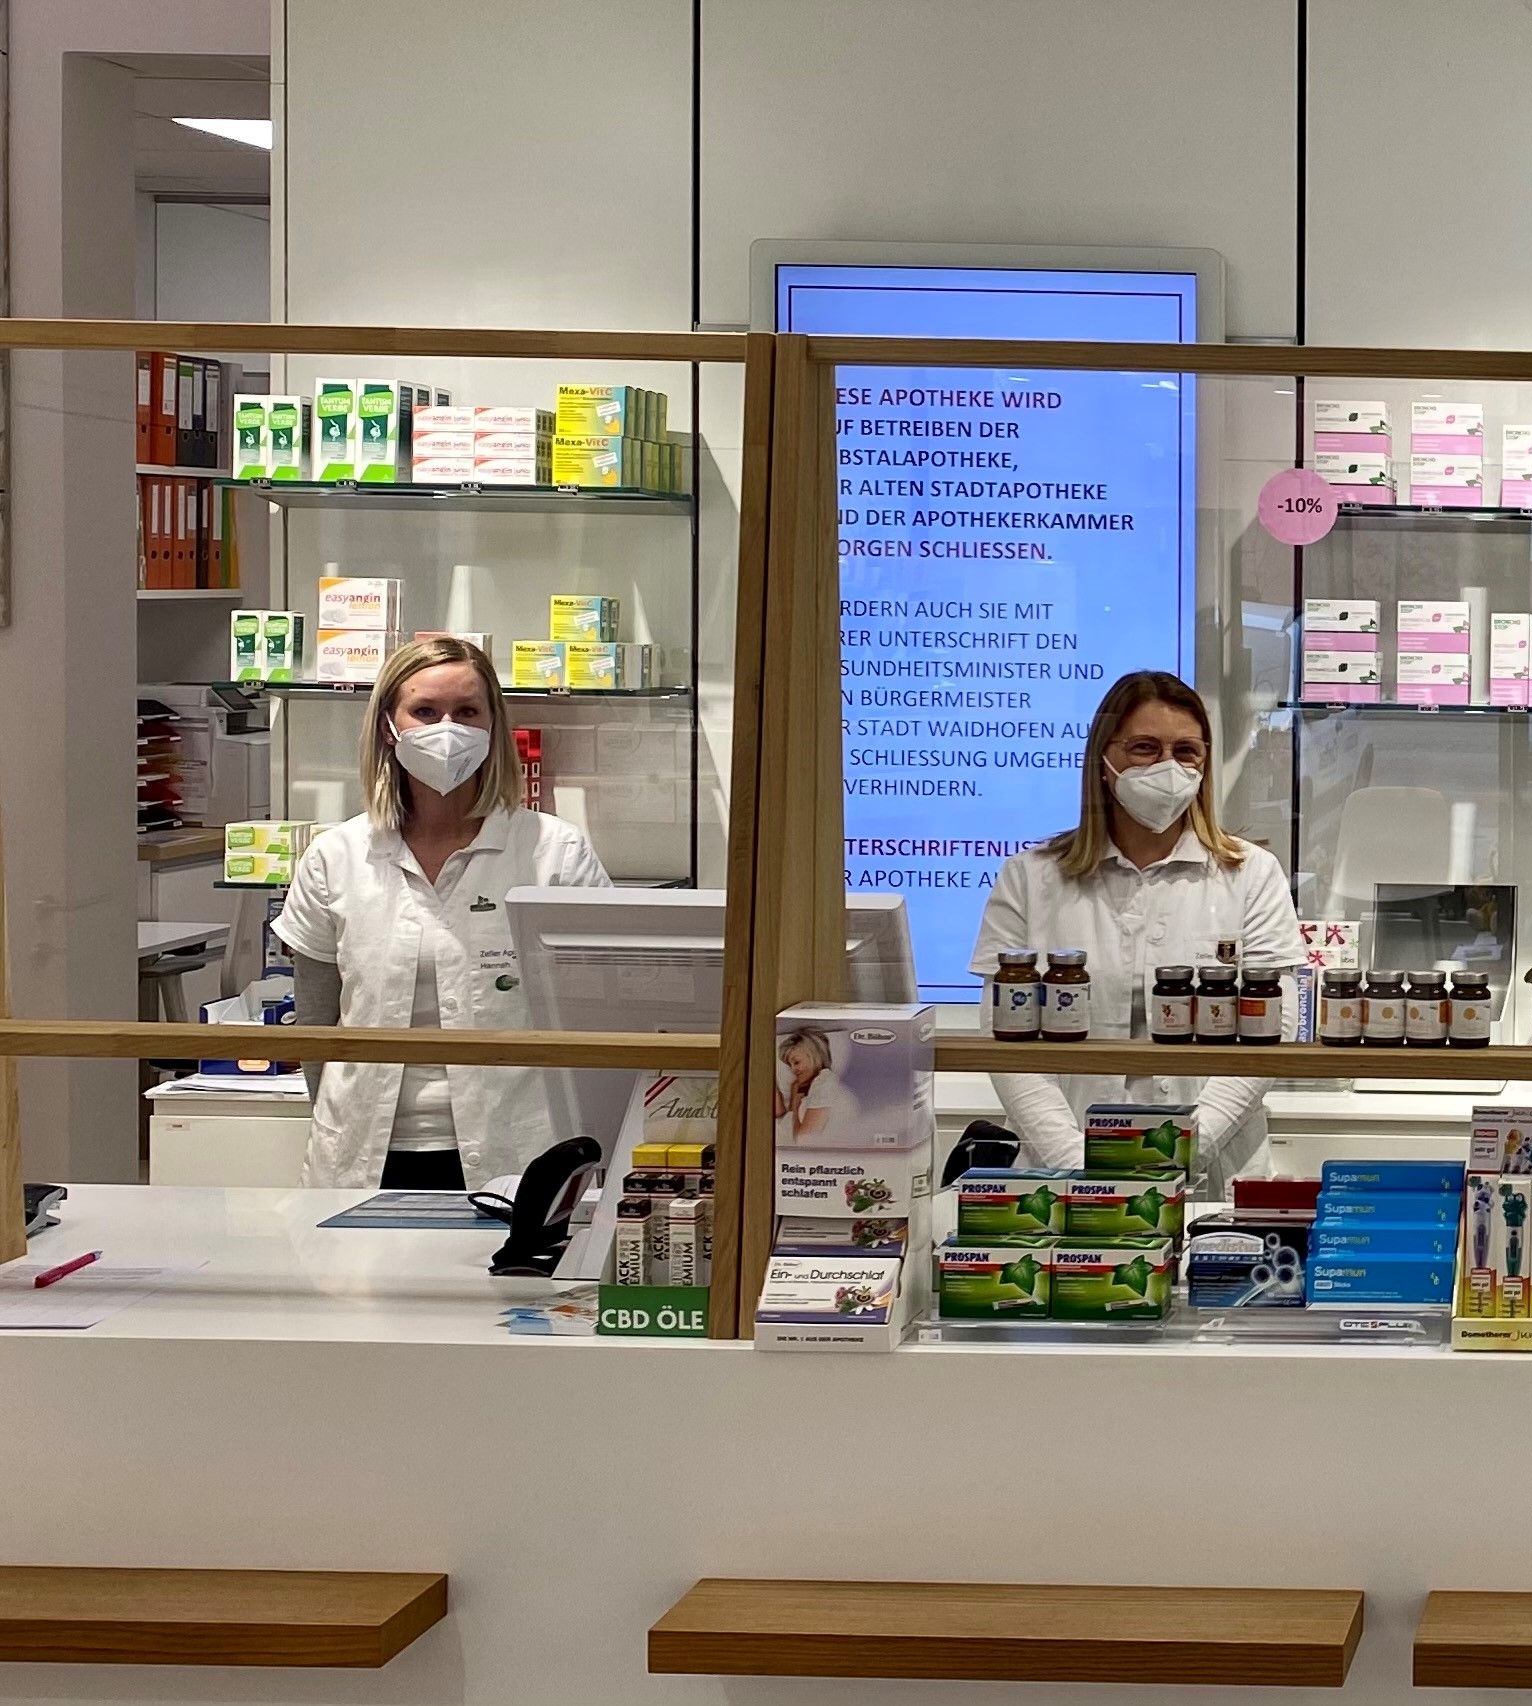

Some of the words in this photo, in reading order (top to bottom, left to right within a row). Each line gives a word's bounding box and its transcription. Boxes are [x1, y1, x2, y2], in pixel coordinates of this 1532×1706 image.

[836, 389, 872, 404] ESE
[879, 389, 994, 408] APOTHEKE
[1002, 391, 1061, 409] WIRD
[860, 419, 972, 438] BETREIBEN
[979, 421, 1019, 439] DER
[840, 449, 1018, 471] BSTALAPOTHEKE,
[858, 479, 924, 497] ALTEN
[930, 481, 1108, 500] STADTAPOTHEKE
[1277, 498, 1323, 514] -10%
[866, 510, 906, 527] DER
[913, 510, 1134, 531] APOTHEKERKAMMER
[838, 539, 912, 558] ORGEN
[919, 540, 1053, 560] SCHLIESSEN.
[326, 593, 381, 604] easyangin
[840, 601, 908, 617] RDERN
[914, 601, 972, 619] AUCH
[979, 602, 1008, 619] SIE
[1015, 602, 1054, 620] MIT
[879, 631, 1028, 649] UNTERSCHRIFT
[1036, 633, 1077, 650] DEN
[323, 645, 378, 656] easyangin
[840, 660, 1052, 679] SUNDHEITSMINISTER
[1058, 663, 1104, 680] UND
[861, 687, 1031, 708] BÜRGERMEISTER
[857, 720, 920, 737] STADT
[929, 721, 1054, 738] WAIDHOFEN
[1061, 723, 1089, 739] AU
[850, 749, 987, 768] SCHLIESSUNG
[994, 751, 1084, 769] UMGEHE
[845, 779, 983, 797] VERHINDERN.
[857, 870, 971, 889] APOTHEKE
[1089, 1118, 1132, 1128] PROSPAN
[782, 1164, 806, 1173] Rein
[809, 1165, 864, 1175] pflanzlich
[1330, 1172, 1380, 1183] Supamun
[782, 1178, 837, 1187] entspannt
[962, 1184, 1006, 1193] PROSPAN
[1071, 1185, 1115, 1195] PROSPAN
[782, 1190, 828, 1198] schlafen
[1325, 1203, 1376, 1214] Supamun
[654, 1236, 663, 1261] ACK
[1319, 1234, 1370, 1245] Supamun
[683, 1242, 693, 1286] EMIUM
[944, 1252, 990, 1262] PROSPAN
[1056, 1254, 1102, 1264] PROSPAN
[618, 1260, 630, 1285] ACK
[770, 1269, 792, 1279] Ein-
[810, 1270, 884, 1279] Durchschlaf
[1314, 1266, 1366, 1278] Supamun
[601, 1308, 650, 1329] CBD
[657, 1305, 704, 1330] ÖLE
